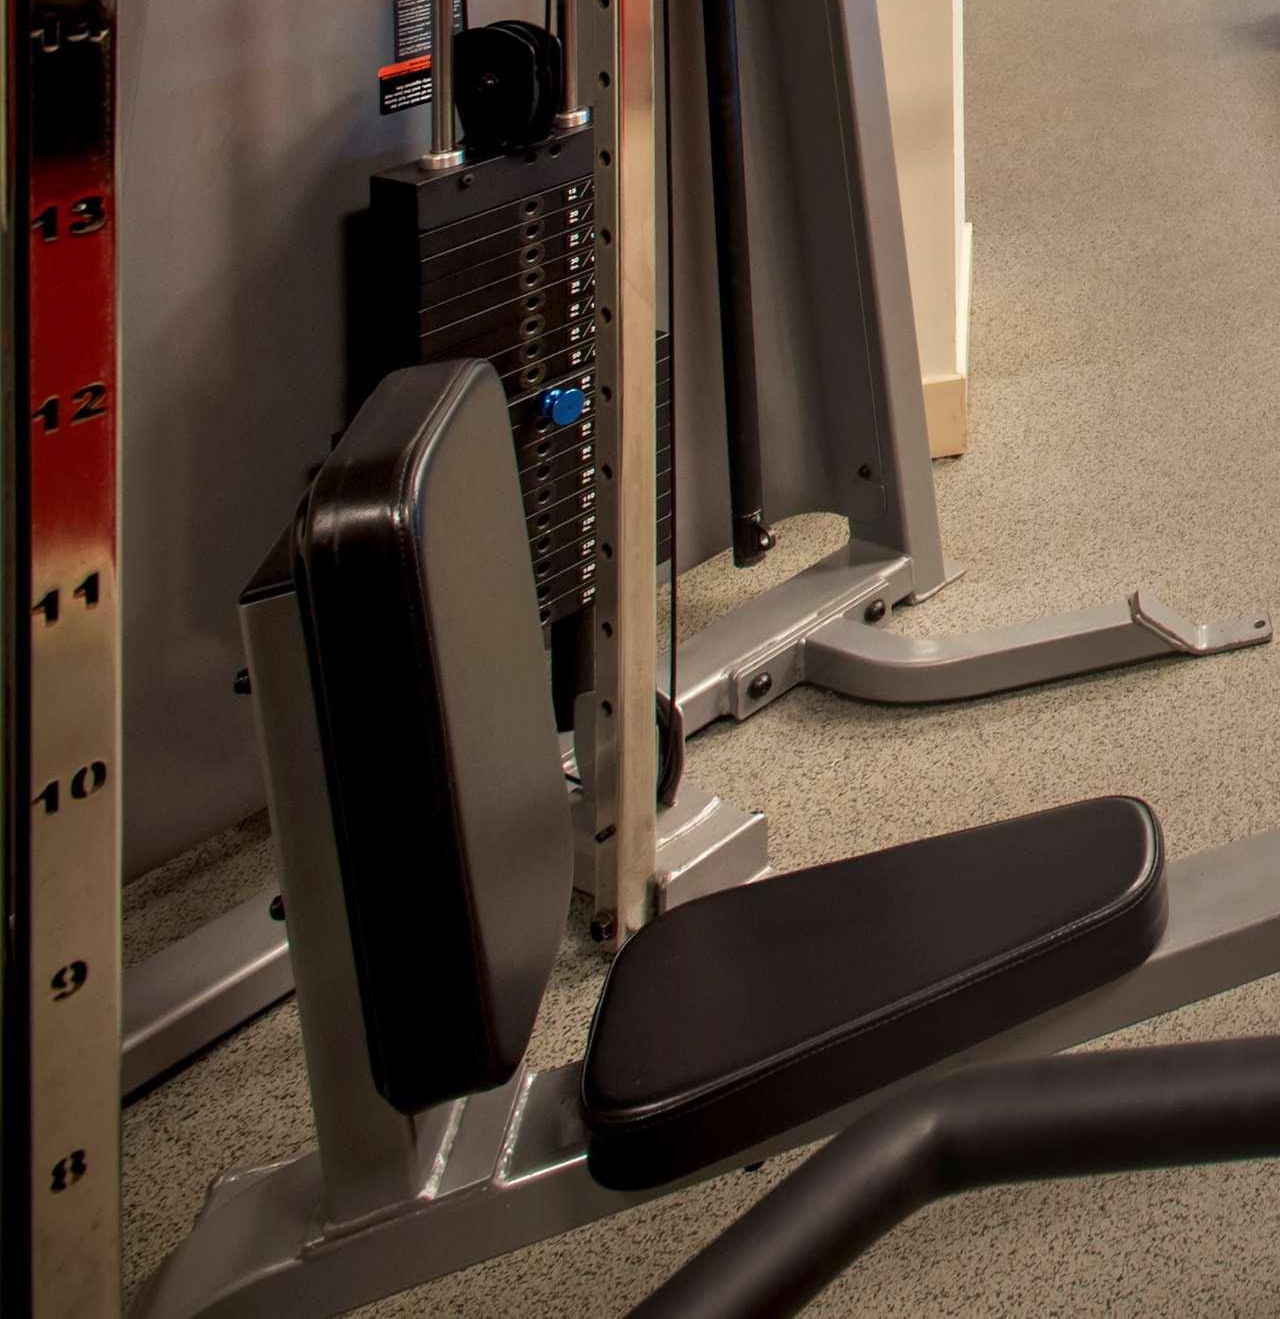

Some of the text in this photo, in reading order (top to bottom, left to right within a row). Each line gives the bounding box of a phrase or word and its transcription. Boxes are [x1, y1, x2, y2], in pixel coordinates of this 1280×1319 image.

[31, 195, 106, 242] 13
[31, 382, 107, 435] 12
[31, 572, 100, 626] 11
[32, 761, 107, 814] 10
[51, 960, 88, 1002] 9
[50, 1148, 86, 1193] 8
